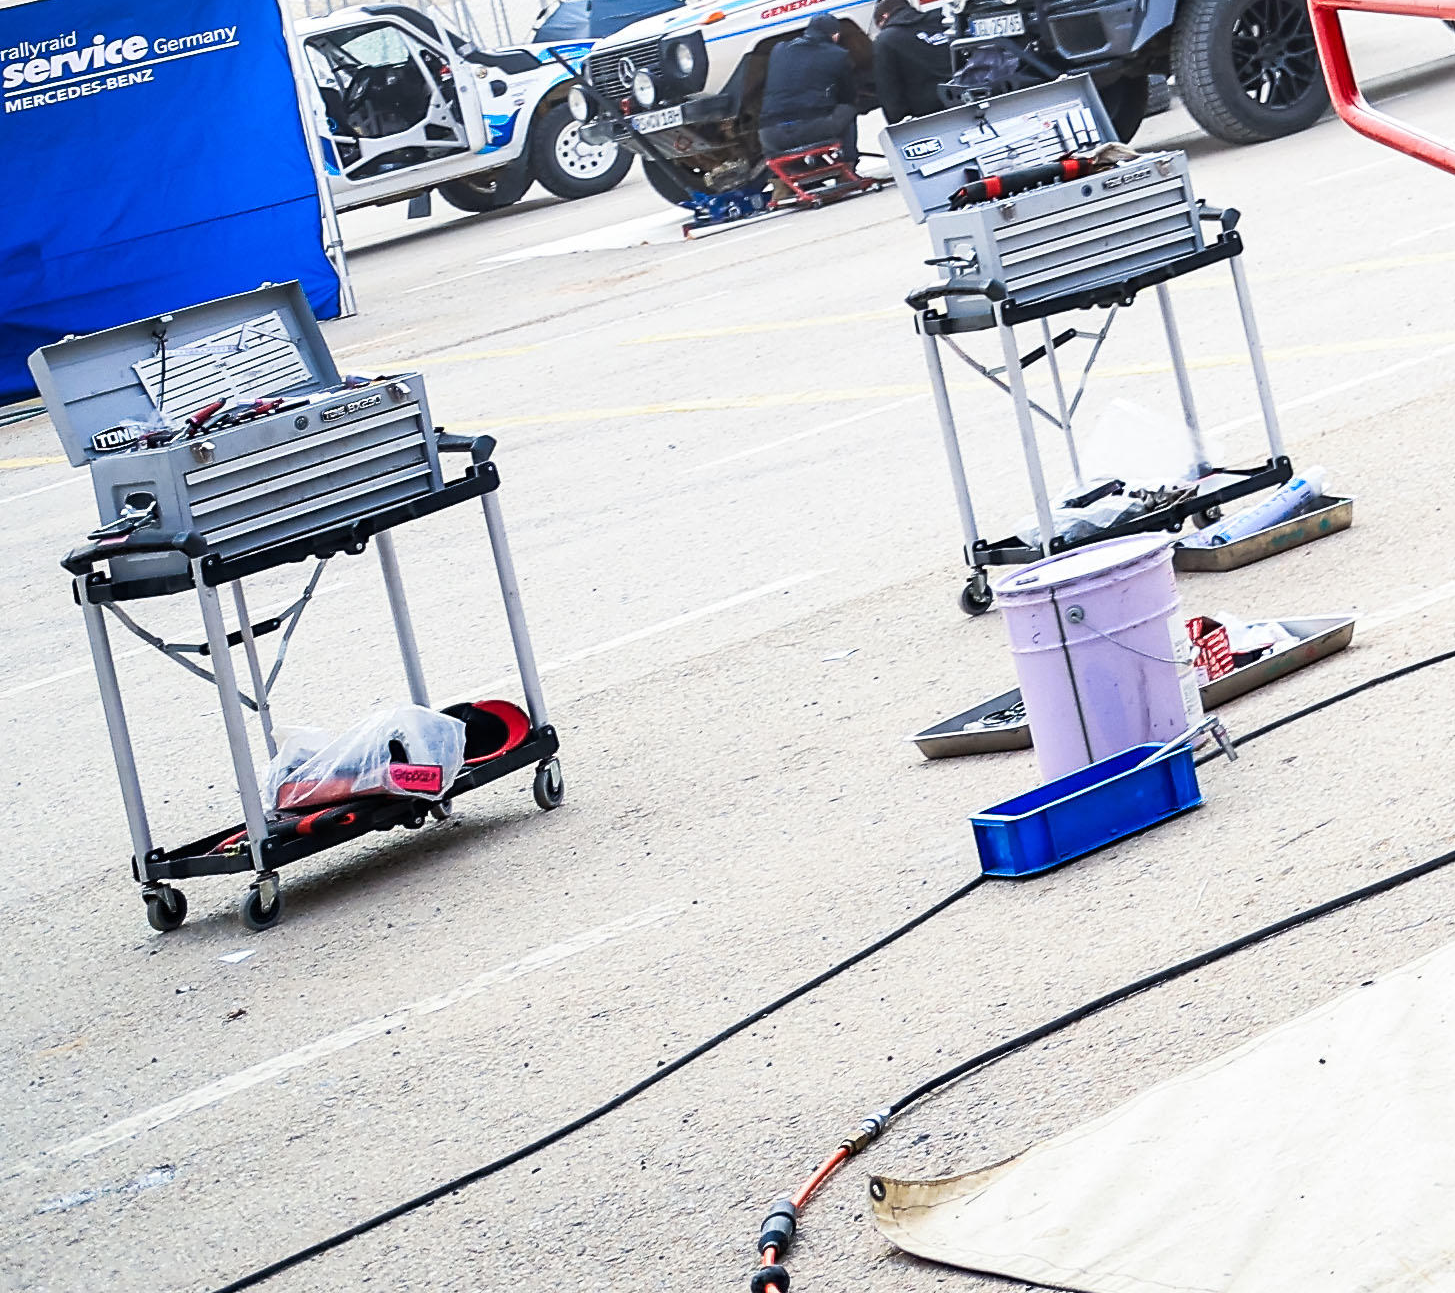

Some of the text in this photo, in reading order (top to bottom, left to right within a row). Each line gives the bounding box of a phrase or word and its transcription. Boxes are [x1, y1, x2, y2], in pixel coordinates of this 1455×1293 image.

[0, 30, 77, 62] rallyraid
[2, 25, 238, 89] service Germany
[4, 68, 155, 114] MERCEDES-BENZ
[904, 139, 941, 157] TONE
